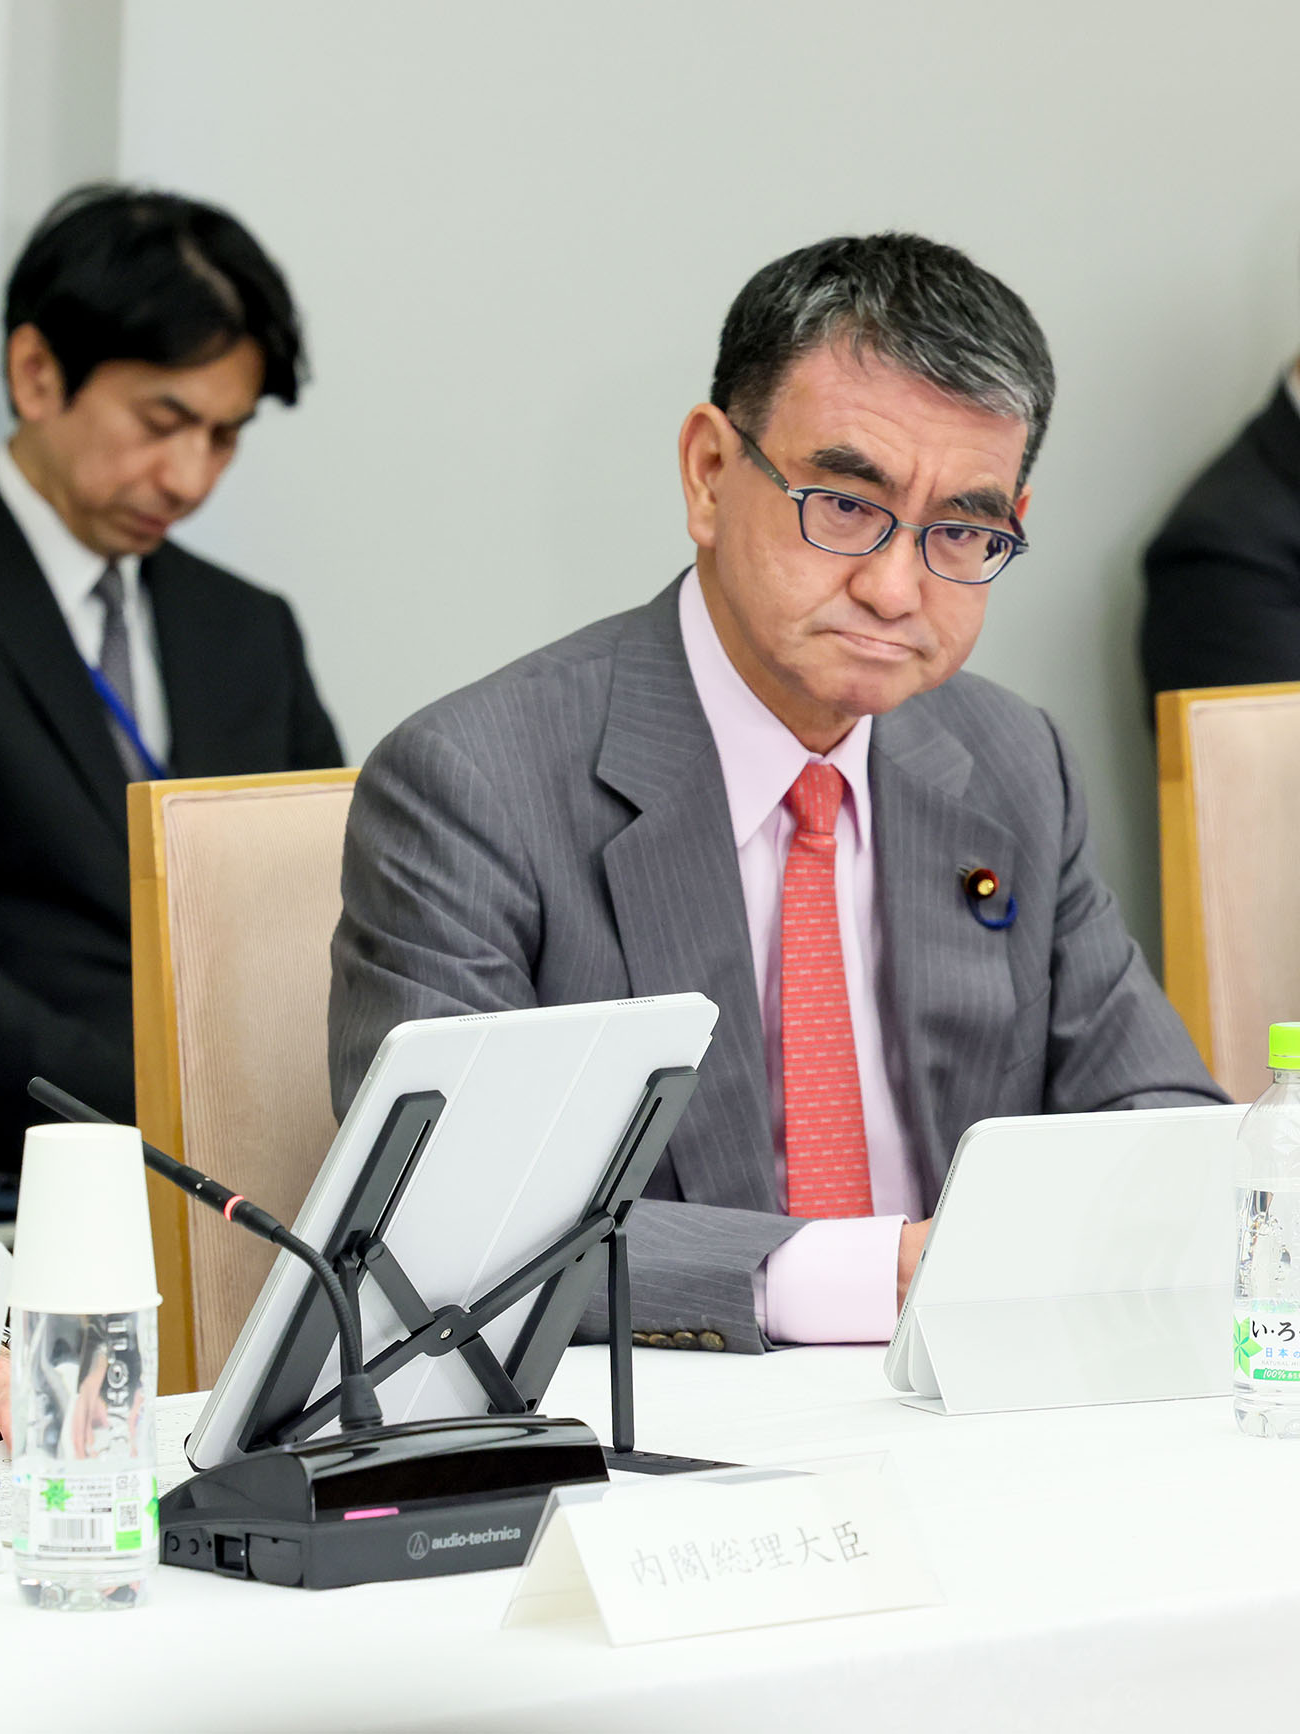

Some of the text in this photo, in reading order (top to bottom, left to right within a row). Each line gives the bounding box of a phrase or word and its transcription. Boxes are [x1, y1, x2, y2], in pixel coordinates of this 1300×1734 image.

[1265, 1347, 1300, 1359] 日本の
[431, 1525, 521, 1550] audio-technica
[630, 1520, 869, 1587] 内閣総理大臣
